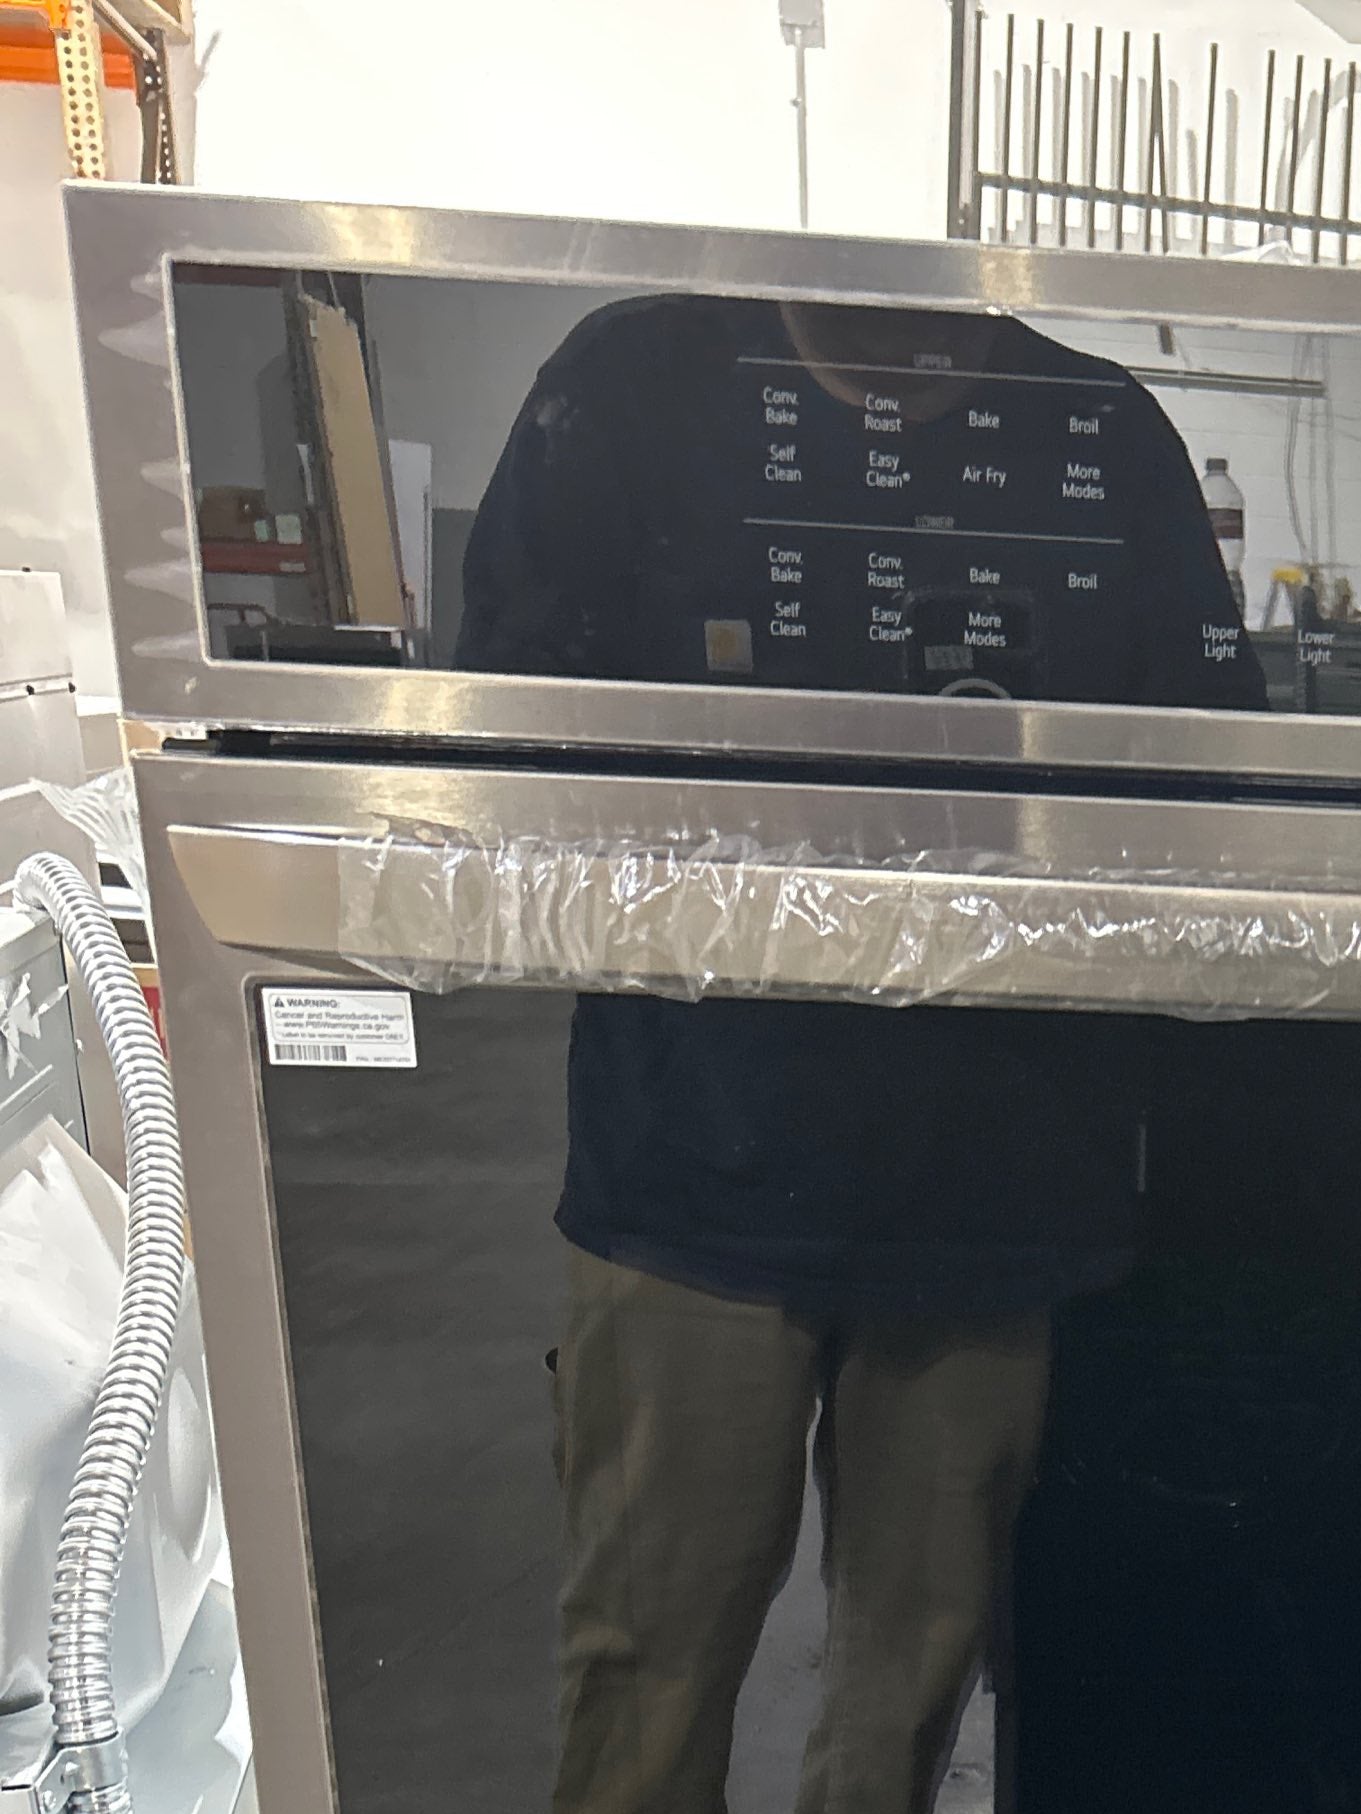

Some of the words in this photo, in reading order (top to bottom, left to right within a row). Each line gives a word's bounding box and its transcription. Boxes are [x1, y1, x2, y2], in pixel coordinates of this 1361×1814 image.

[763, 385, 799, 405] Conv.
[865, 393, 900, 412] Conv.
[765, 407, 798, 425] Bake
[864, 413, 902, 432] Roast
[968, 410, 1000, 429] Bake
[1069, 416, 1099, 434] Broil
[769, 444, 796, 461] Self
[869, 450, 899, 472] Easy
[765, 464, 802, 482] Clean
[963, 465, 982, 483] Air
[986, 467, 1006, 488] Fry
[1067, 463, 1101, 480] More
[1062, 482, 1105, 500] Modes
[768, 546, 803, 565] Conv.
[868, 552, 903, 570] Conv.
[771, 566, 802, 583] Bake
[868, 572, 905, 589] Roast
[969, 567, 1000, 584] Bake
[1068, 572, 1097, 589] Broil
[775, 601, 801, 618] Self
[872, 606, 902, 627] Easy
[770, 620, 806, 637] Clean
[968, 611, 1002, 628] More
[964, 630, 1006, 647] Modes
[1202, 624, 1240, 641] Upper
[1297, 629, 1335, 645] Lower
[1204, 643, 1237, 662] Light
[1299, 648, 1332, 666] Light
